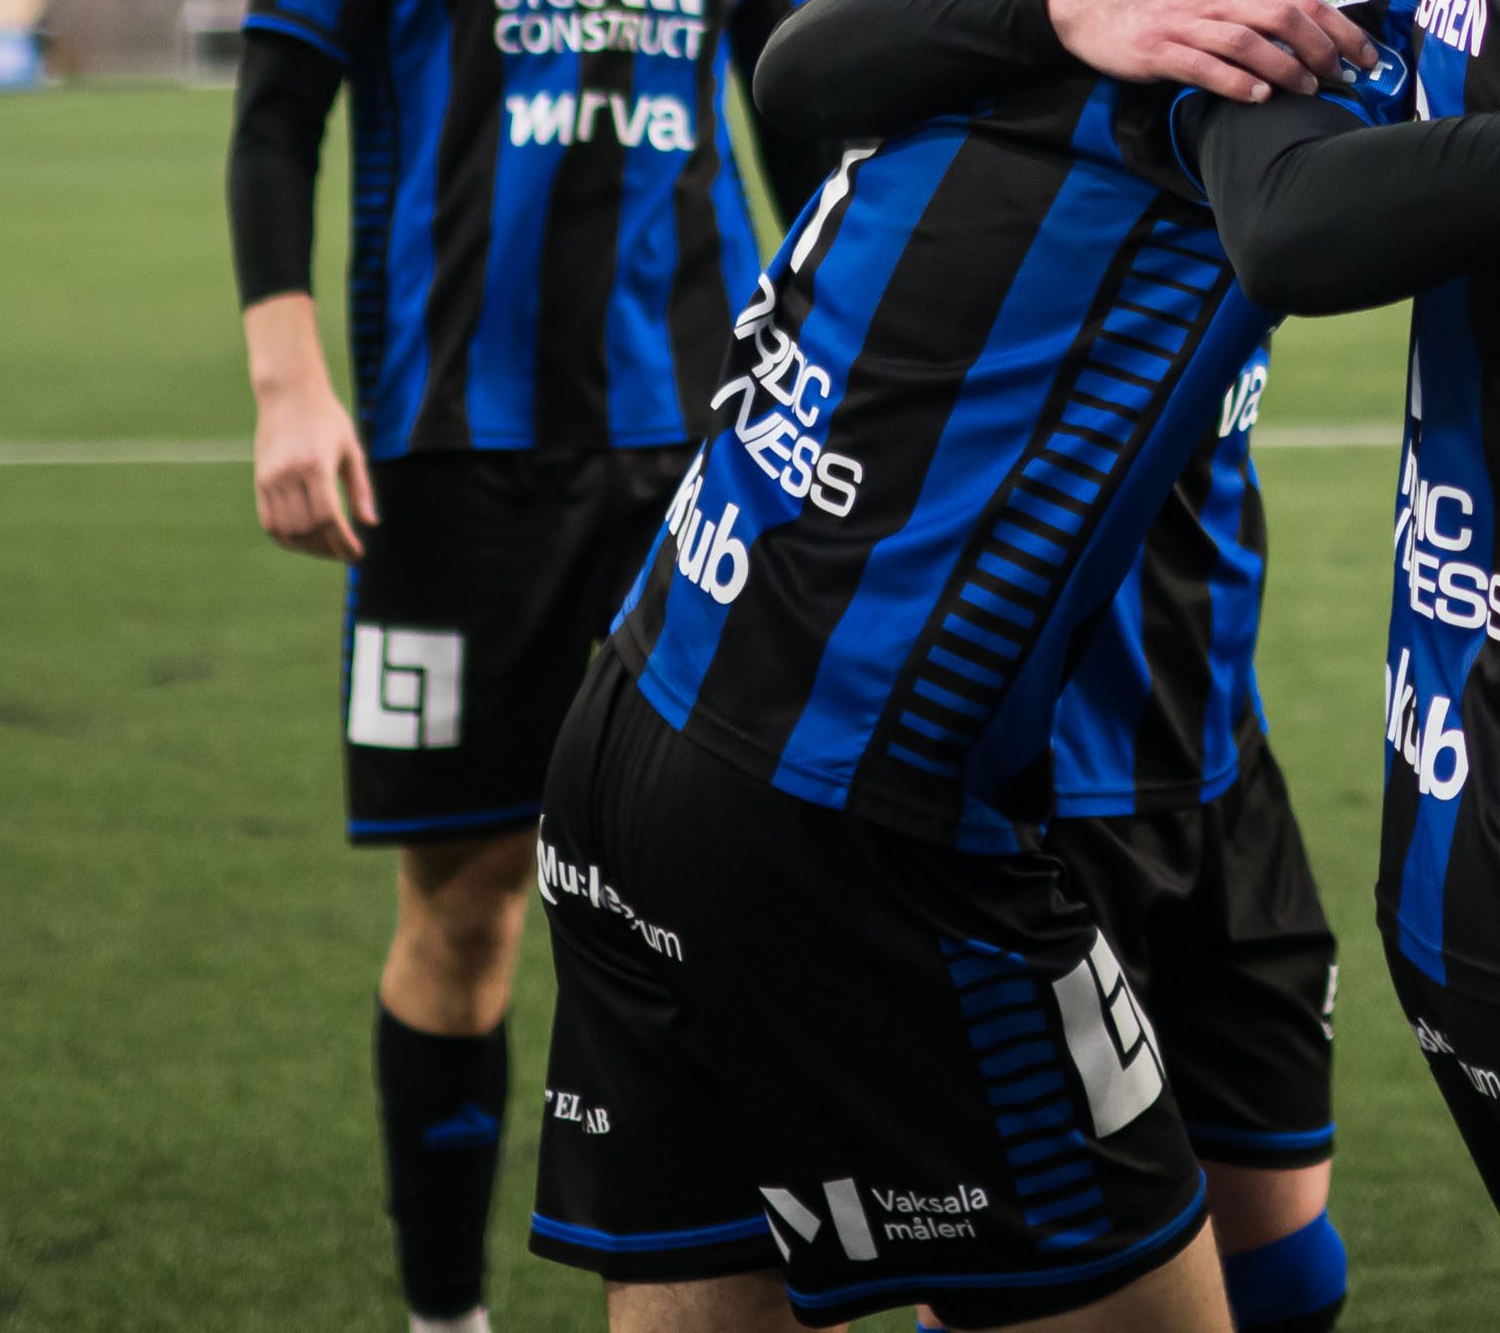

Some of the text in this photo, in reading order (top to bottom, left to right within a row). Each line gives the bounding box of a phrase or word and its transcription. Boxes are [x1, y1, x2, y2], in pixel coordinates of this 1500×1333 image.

[493, 10, 708, 61] CONSTRUCT
[870, 1184, 990, 1213] Vaksala
[883, 1216, 977, 1241] måleri
